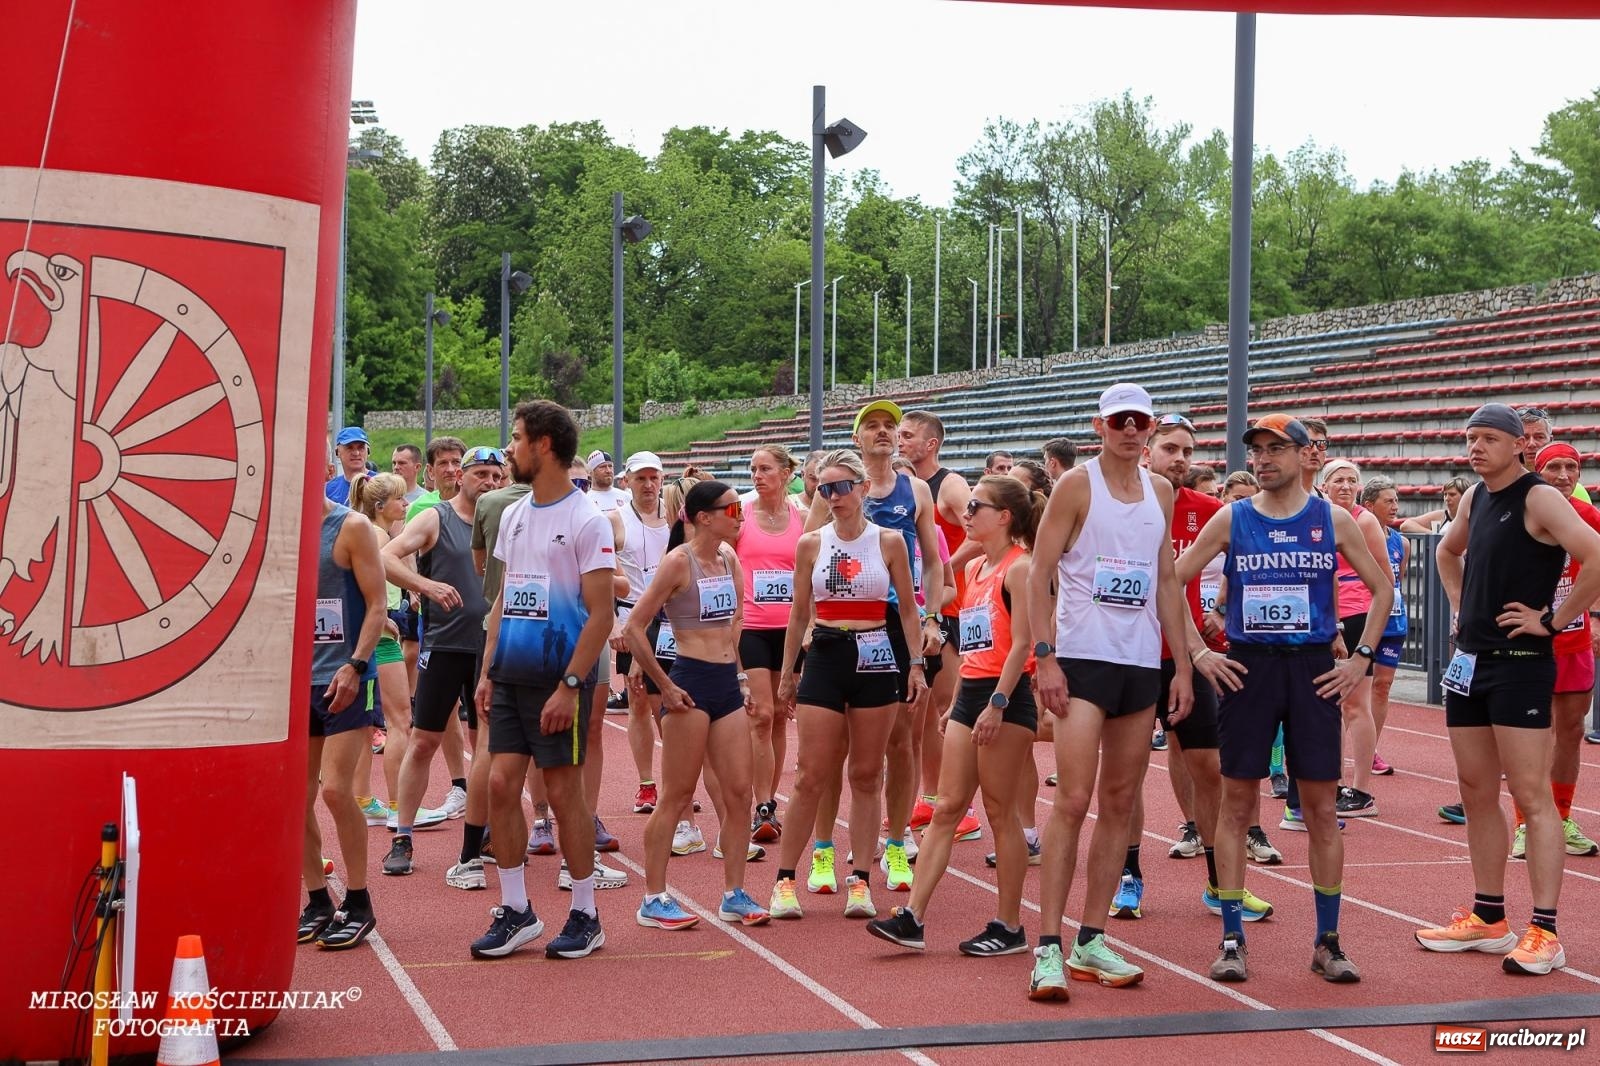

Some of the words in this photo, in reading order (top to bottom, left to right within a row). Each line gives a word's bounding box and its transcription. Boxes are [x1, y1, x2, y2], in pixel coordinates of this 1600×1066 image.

[1235, 551, 1334, 572] RUNNERS
[1252, 571, 1296, 580] EKO-OKNA
[1298, 571, 1318, 579] TEAM
[766, 583, 788, 595] 216
[1110, 577, 1142, 596] 220
[513, 591, 537, 607] 205
[713, 593, 732, 608] 173
[1259, 604, 1292, 621] 163
[967, 624, 982, 641] 210
[871, 648, 894, 663] 223
[1448, 663, 1463, 681] 193
